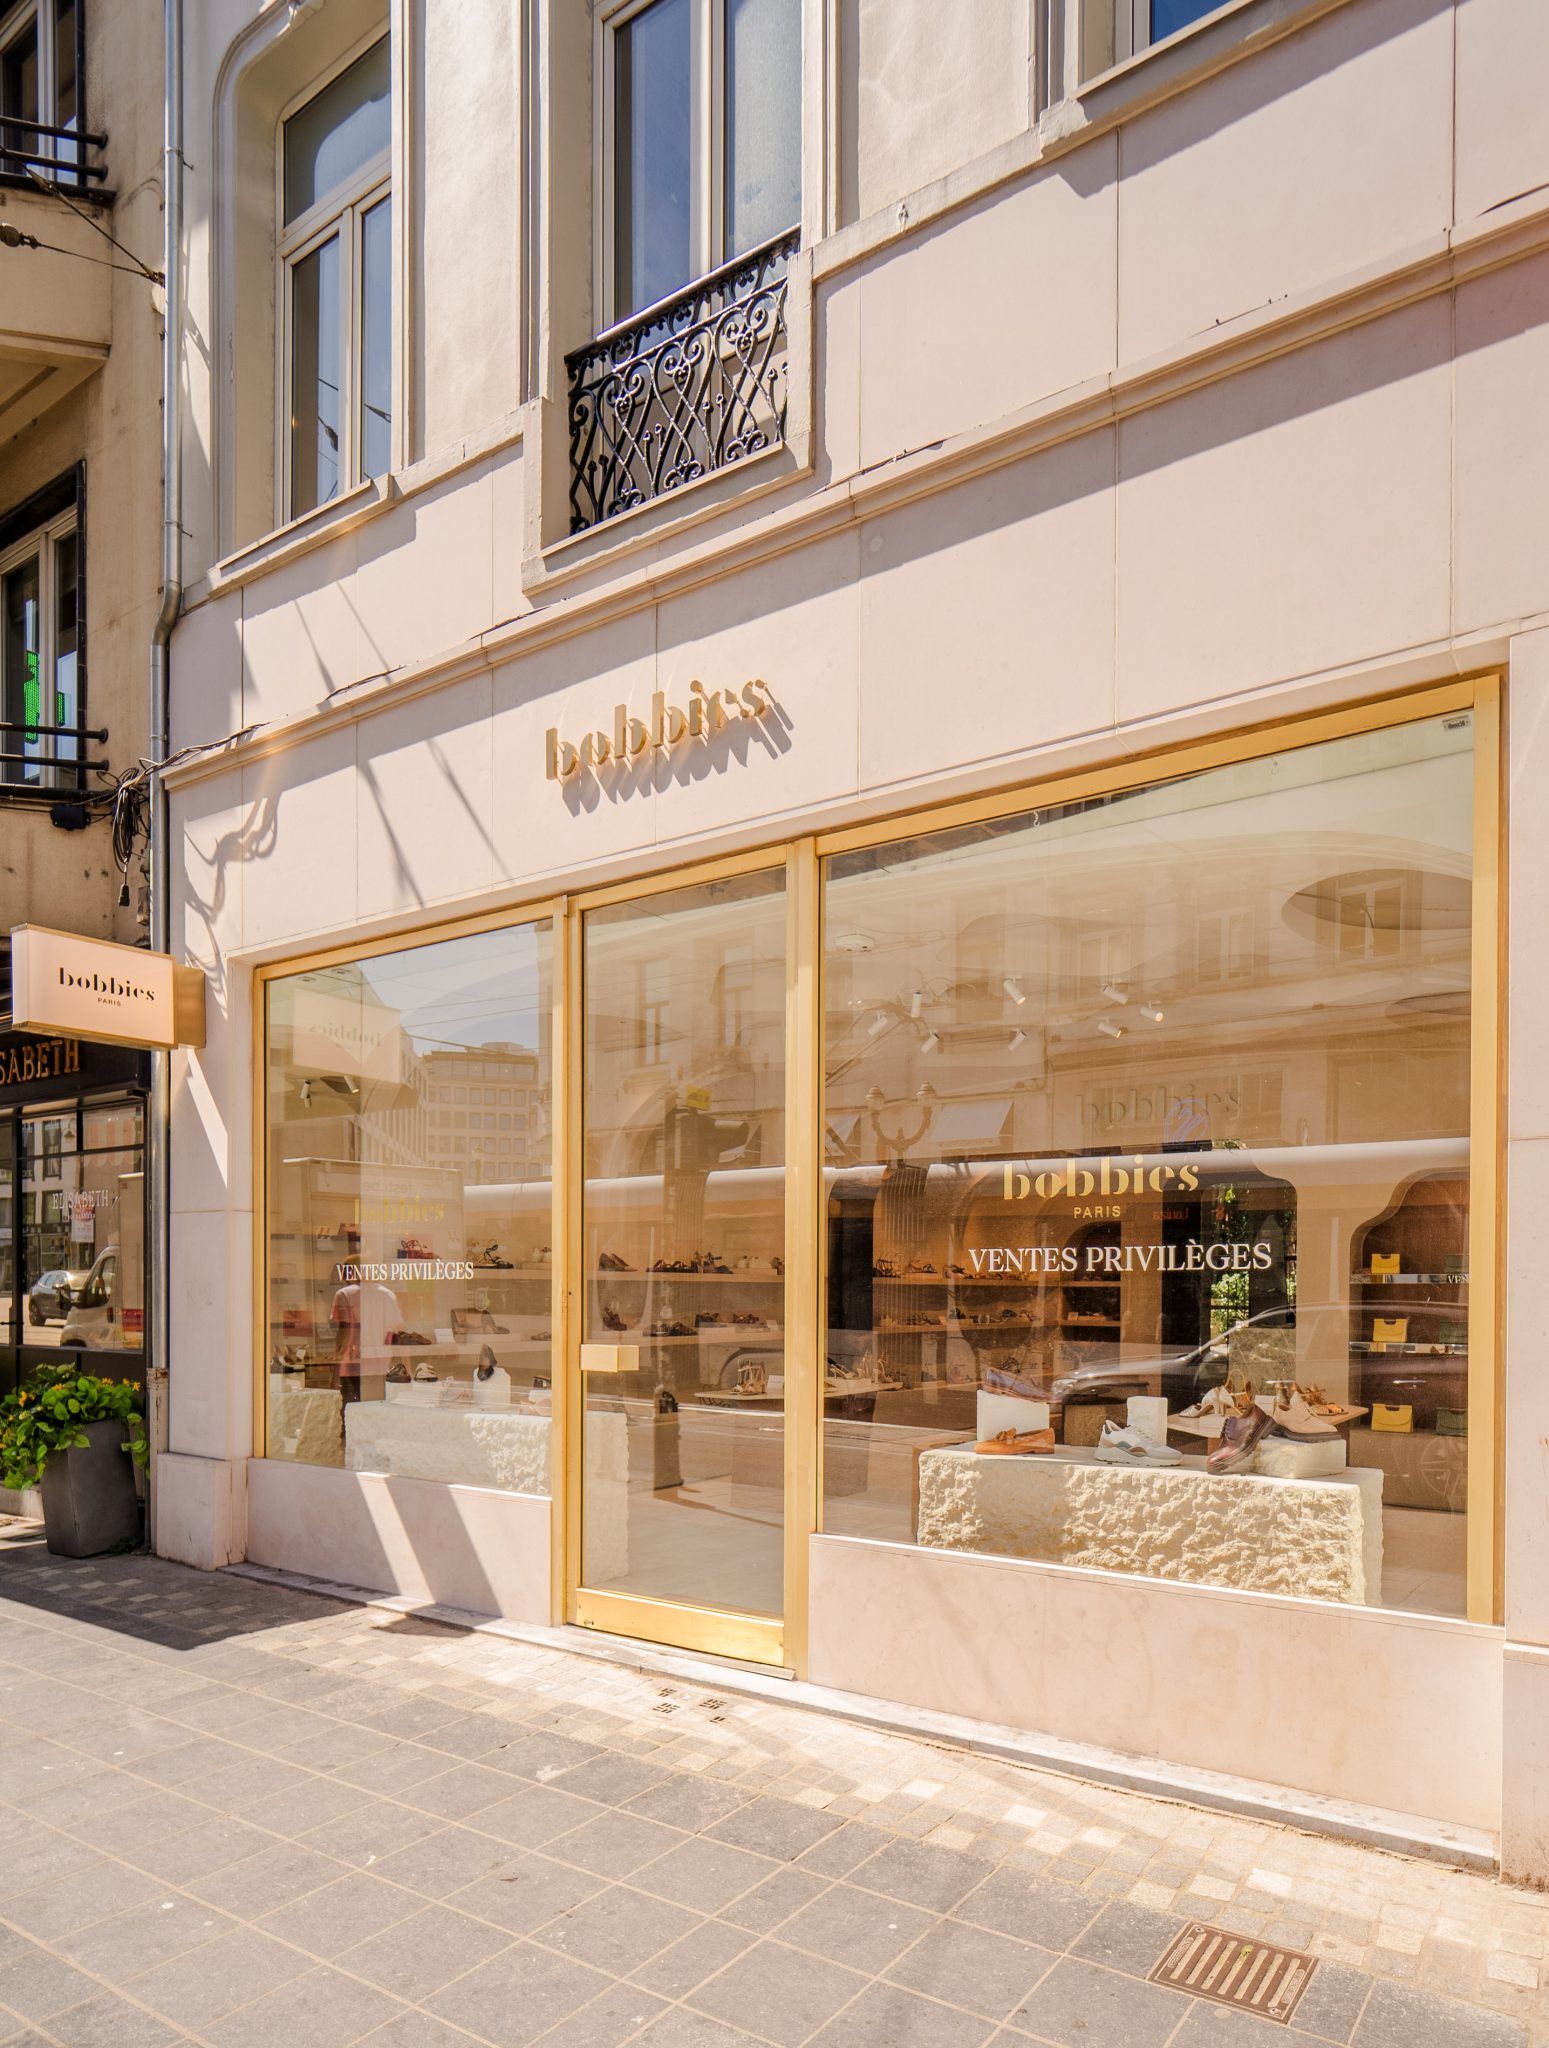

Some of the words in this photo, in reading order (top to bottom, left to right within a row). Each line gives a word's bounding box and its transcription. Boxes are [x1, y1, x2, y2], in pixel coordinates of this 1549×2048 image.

[546, 679, 766, 780] bobbies
[59, 967, 155, 1001] bobbies
[97, 997, 121, 1007] PARIS
[1003, 1154, 1199, 1200] bobbies
[52, 1190, 109, 1210] ELISABETH
[1073, 1206, 1121, 1219] PARIS
[336, 1263, 388, 1281] VENTES
[390, 1258, 474, 1281] PRIVILÈGES
[969, 1247, 1077, 1272] VENTES
[1085, 1239, 1272, 1271] PRIVILÈGES
